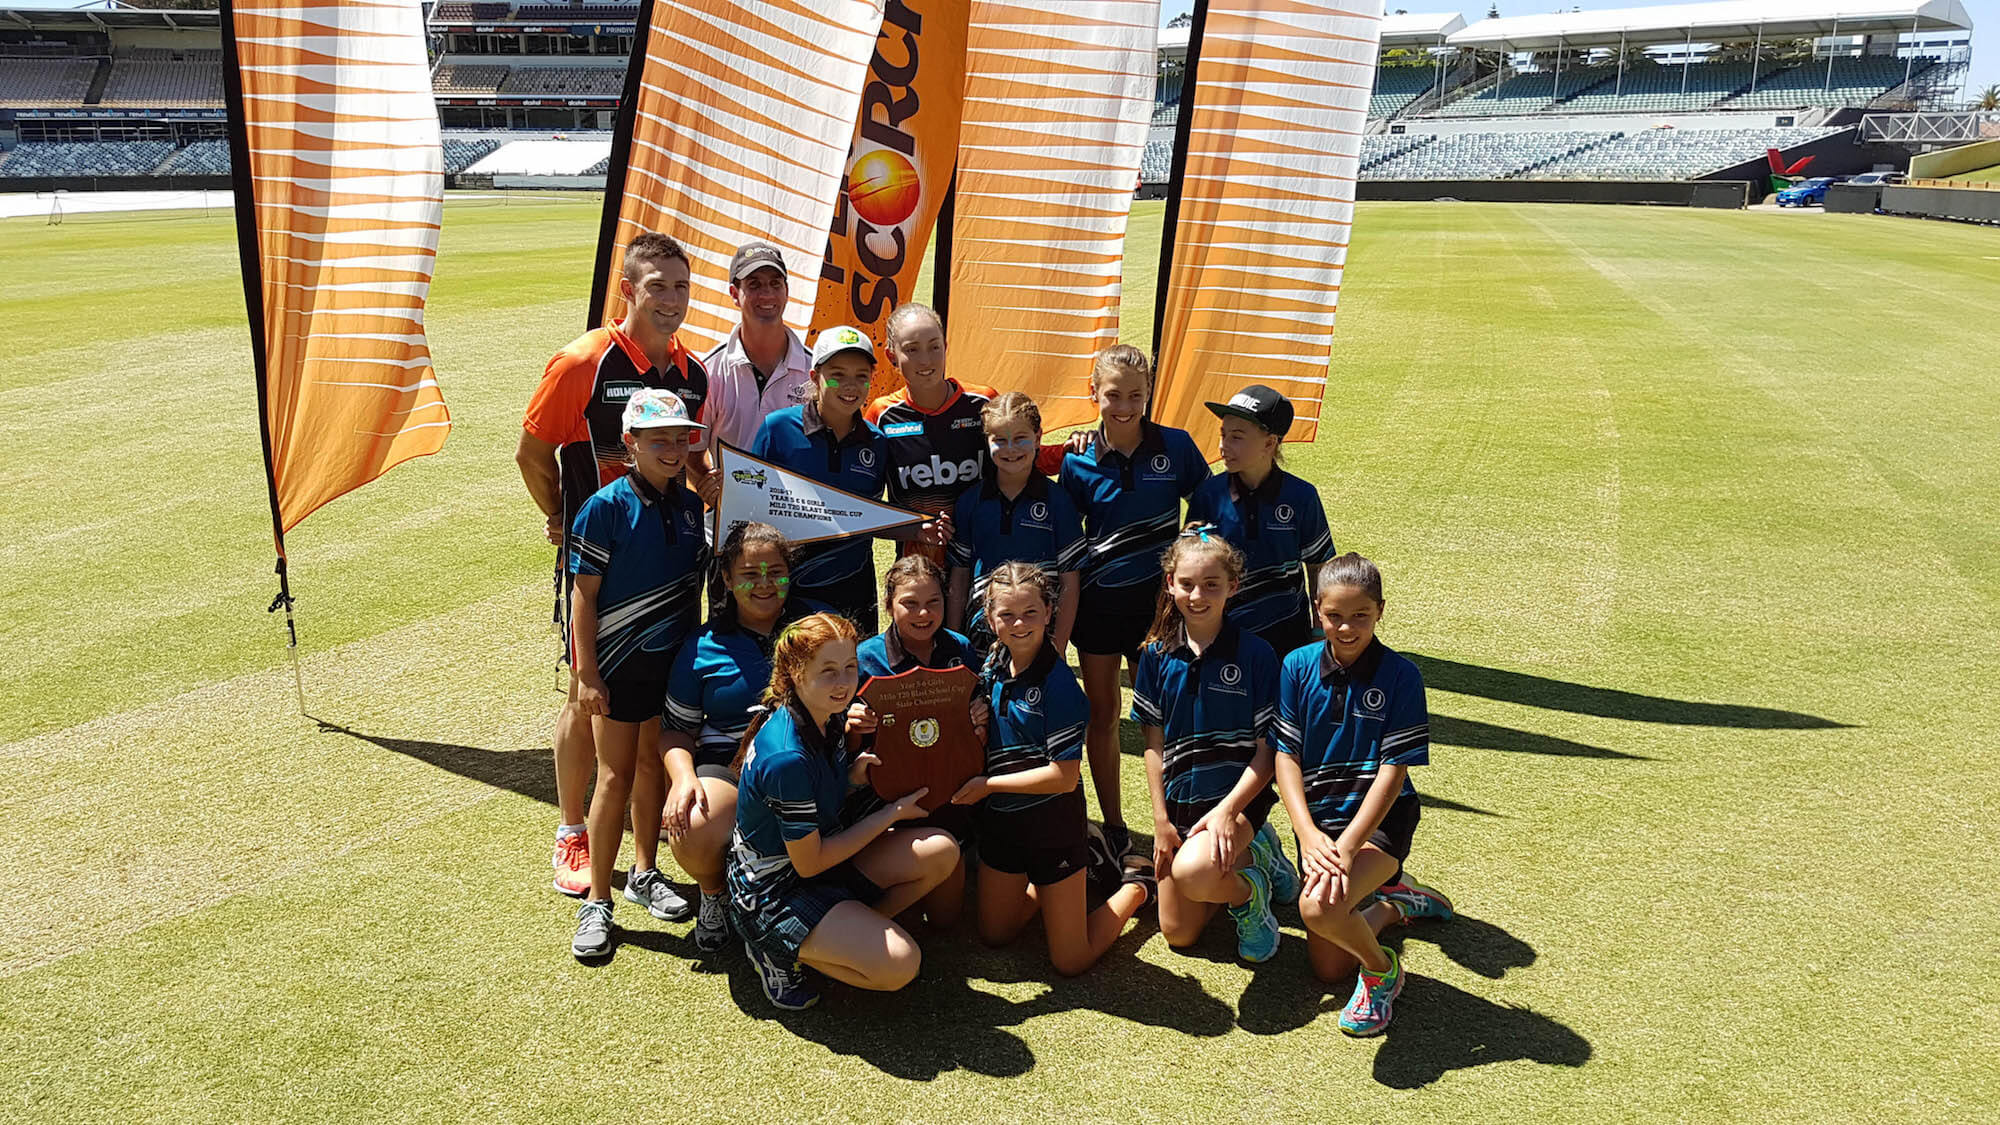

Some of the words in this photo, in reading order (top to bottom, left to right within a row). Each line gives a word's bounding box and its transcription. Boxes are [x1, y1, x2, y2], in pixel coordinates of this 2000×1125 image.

[898, 450, 984, 490] rebel
[770, 494, 789, 502] YEAR
[807, 499, 825, 507] GIRLS
[769, 509, 792, 517] STATE
[793, 511, 832, 522] CHAMPIONS
[788, 503, 801, 511] T20
[801, 505, 822, 514] BLAST
[823, 508, 848, 517] SCHOOL
[928, 685, 951, 695] School
[951, 685, 966, 694] Cup
[896, 701, 913, 709] State
[914, 697, 952, 706] Champions
